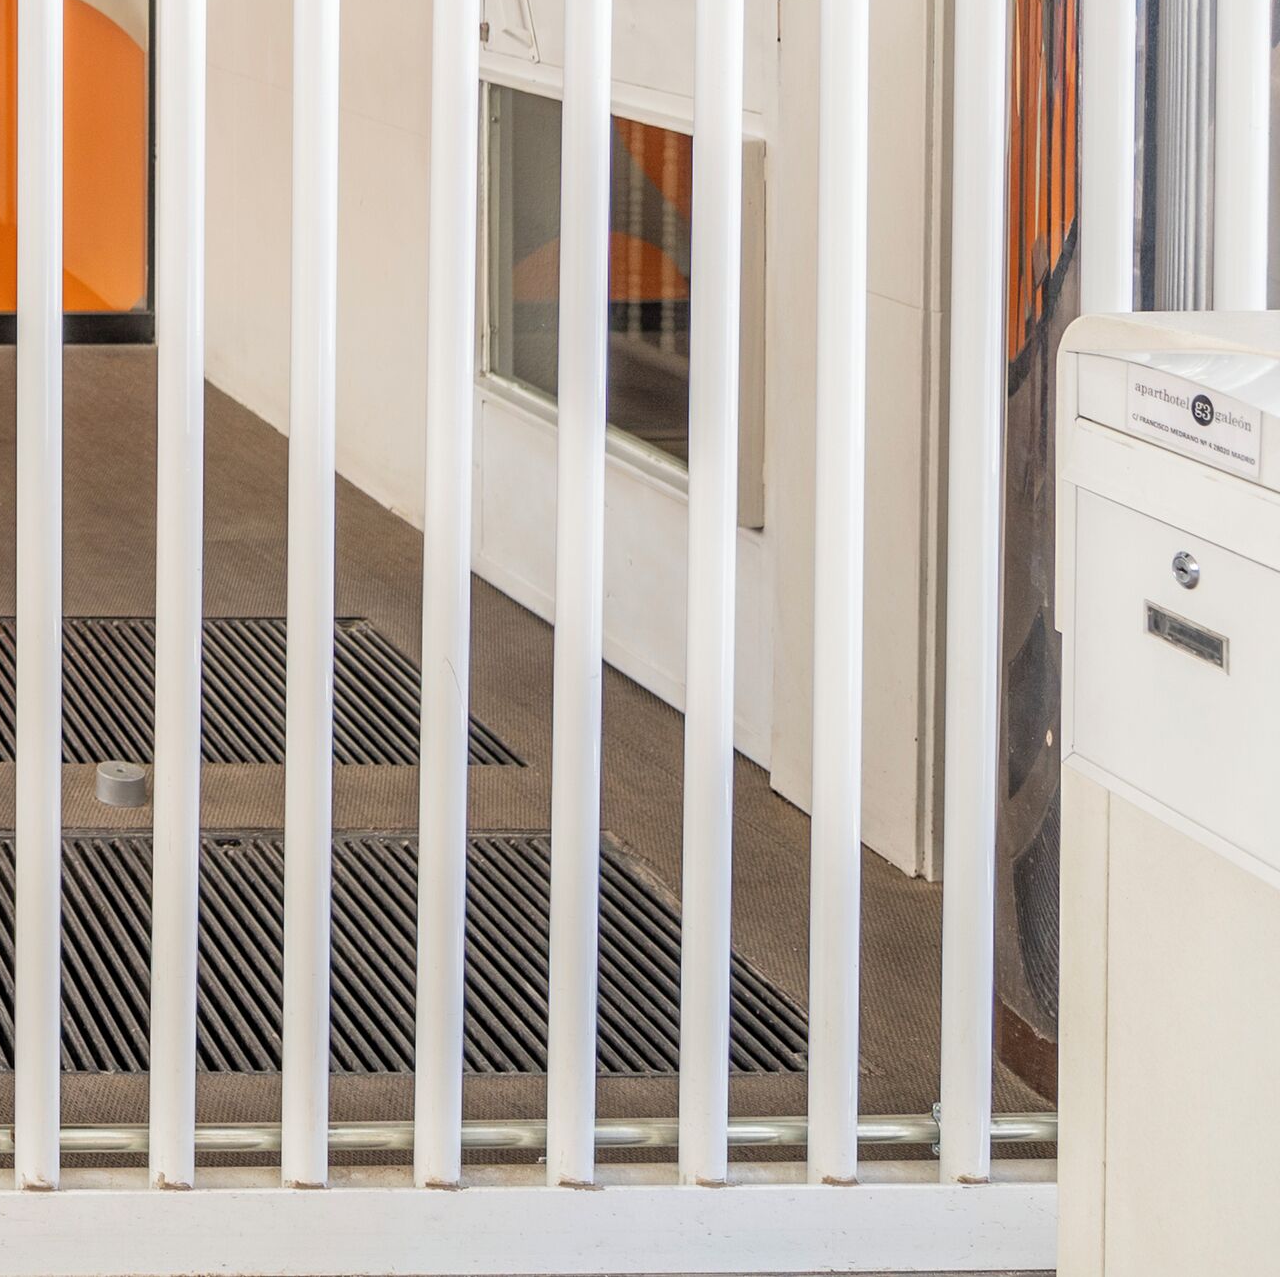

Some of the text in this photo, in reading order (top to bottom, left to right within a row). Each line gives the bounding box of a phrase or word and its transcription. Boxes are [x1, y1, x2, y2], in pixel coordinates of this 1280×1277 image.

[1135, 382, 1252, 432] aparthotel g3 galeón
[1139, 415, 1169, 433] FRANCISCO
[1170, 427, 1199, 444] MEDRANO
[1231, 451, 1256, 466] MADRID
